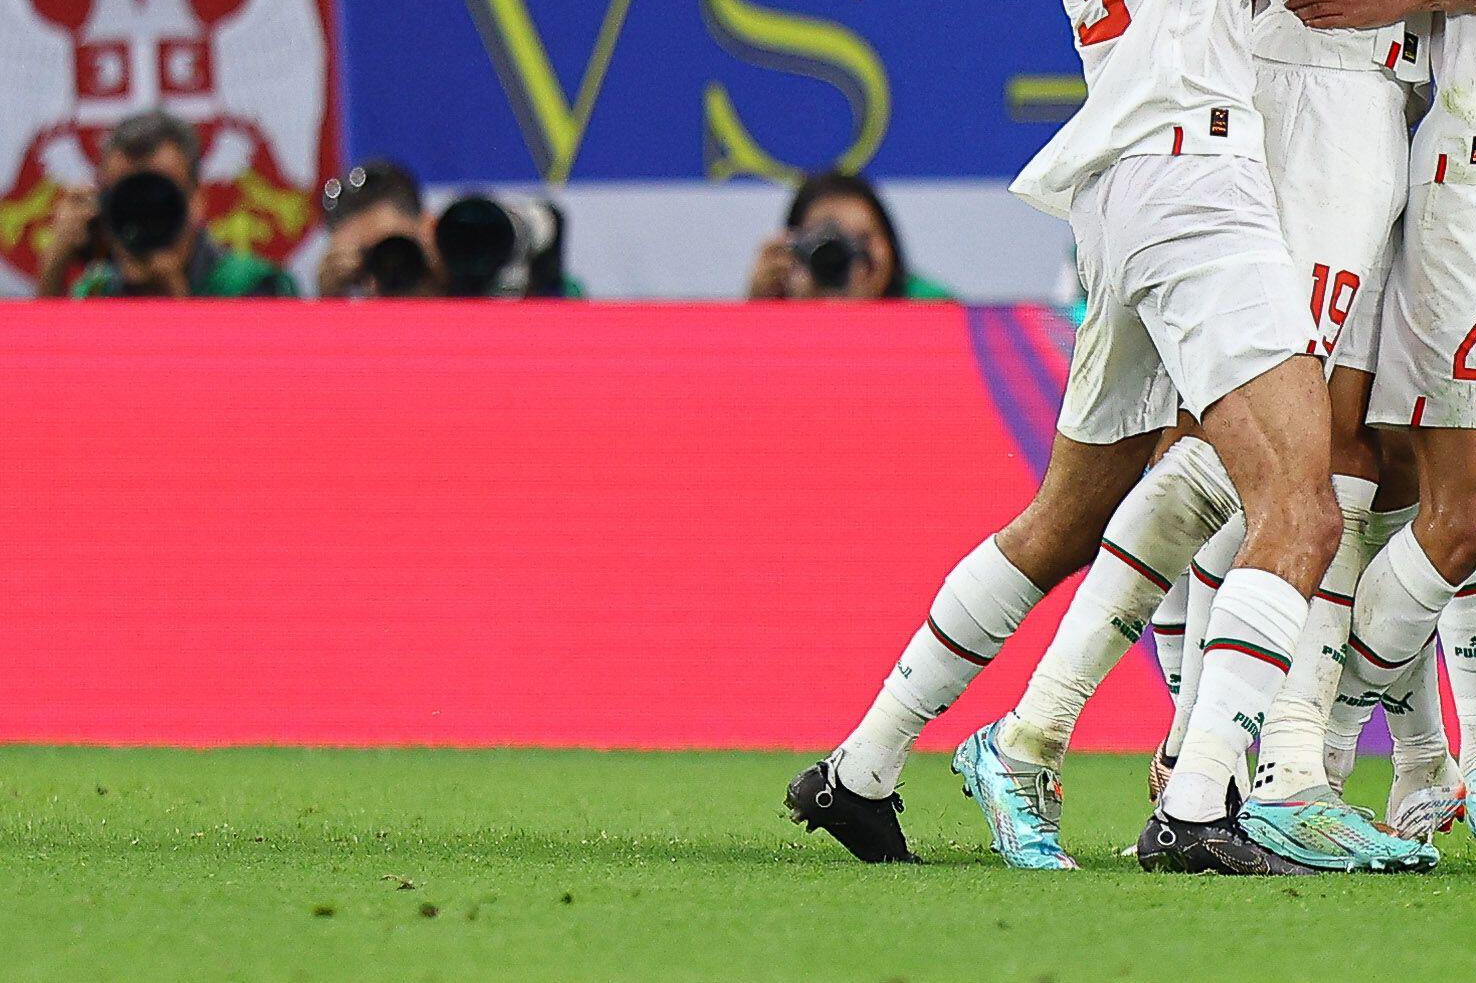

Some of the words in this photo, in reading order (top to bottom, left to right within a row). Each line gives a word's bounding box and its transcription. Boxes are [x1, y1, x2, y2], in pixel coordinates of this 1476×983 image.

[1309, 263, 1361, 357] 19
[1111, 616, 1141, 644] PUM
[1232, 711, 1259, 740] PUM
